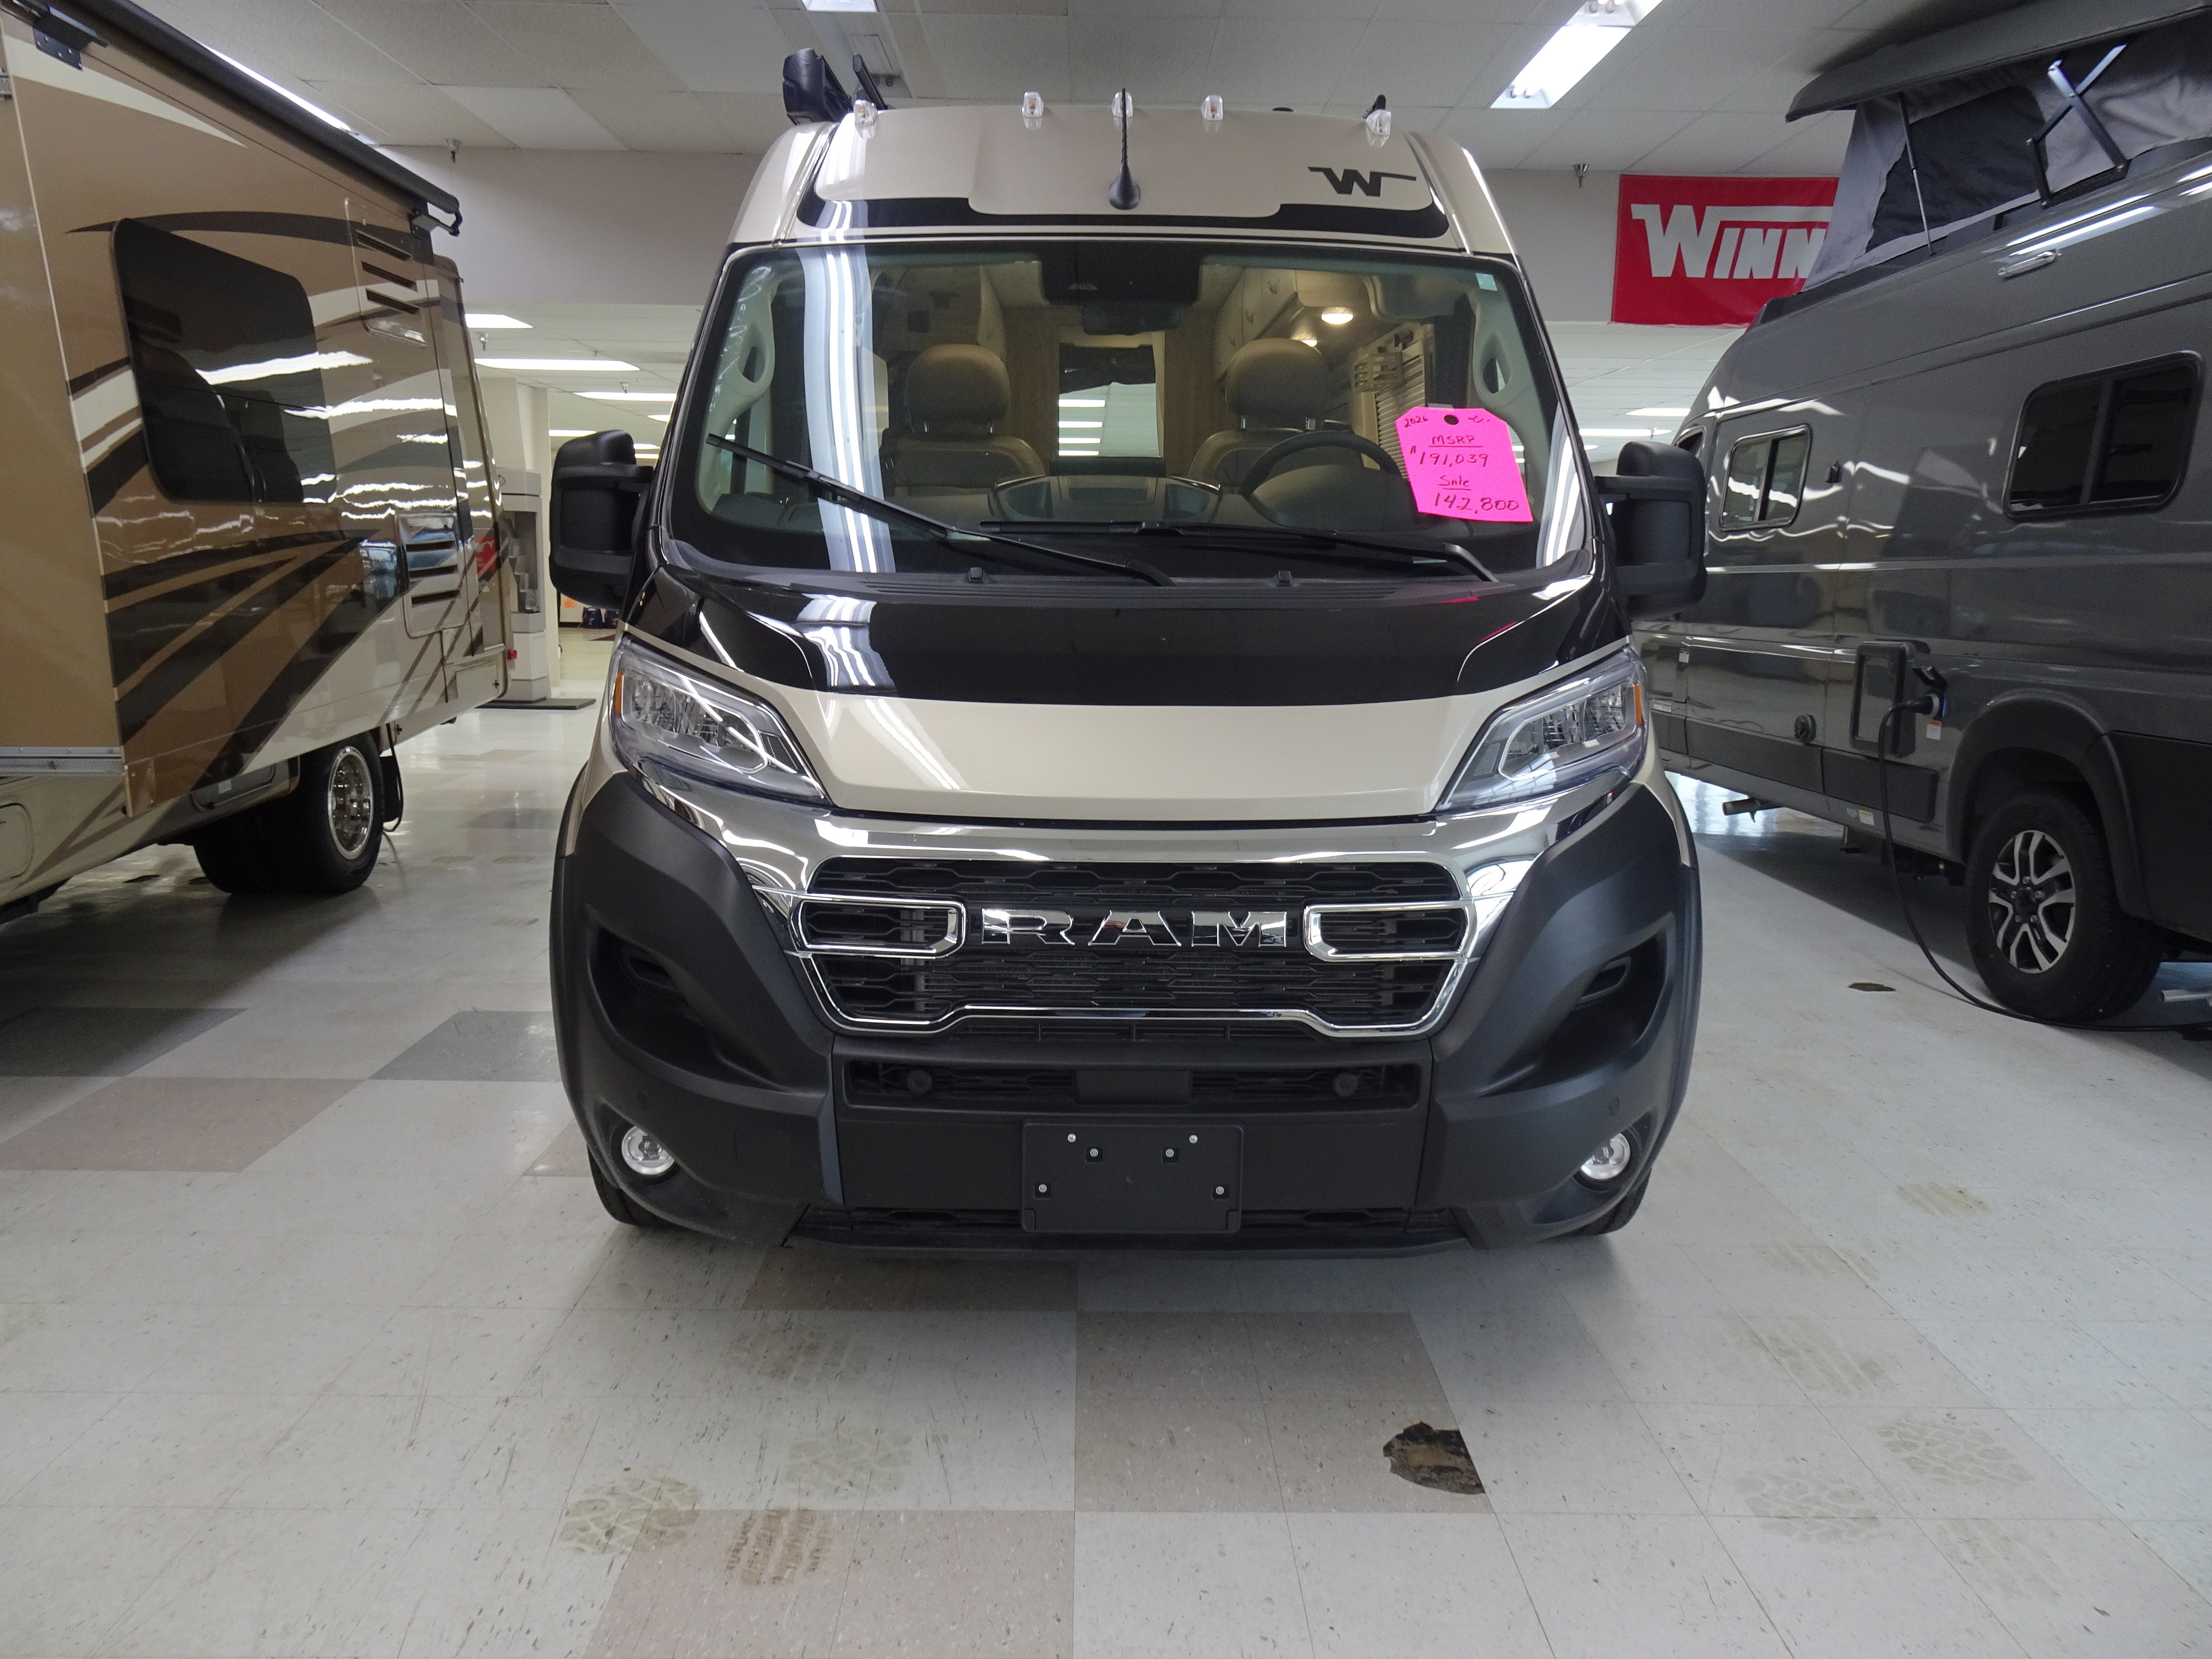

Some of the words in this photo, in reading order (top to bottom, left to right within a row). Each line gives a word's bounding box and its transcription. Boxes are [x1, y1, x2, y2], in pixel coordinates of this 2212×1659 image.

[1432, 435, 1475, 445] MSRP
[1438, 475, 1469, 487] Sale
[1435, 493, 1519, 514] 142,800
[982, 908, 1288, 947] RAM
